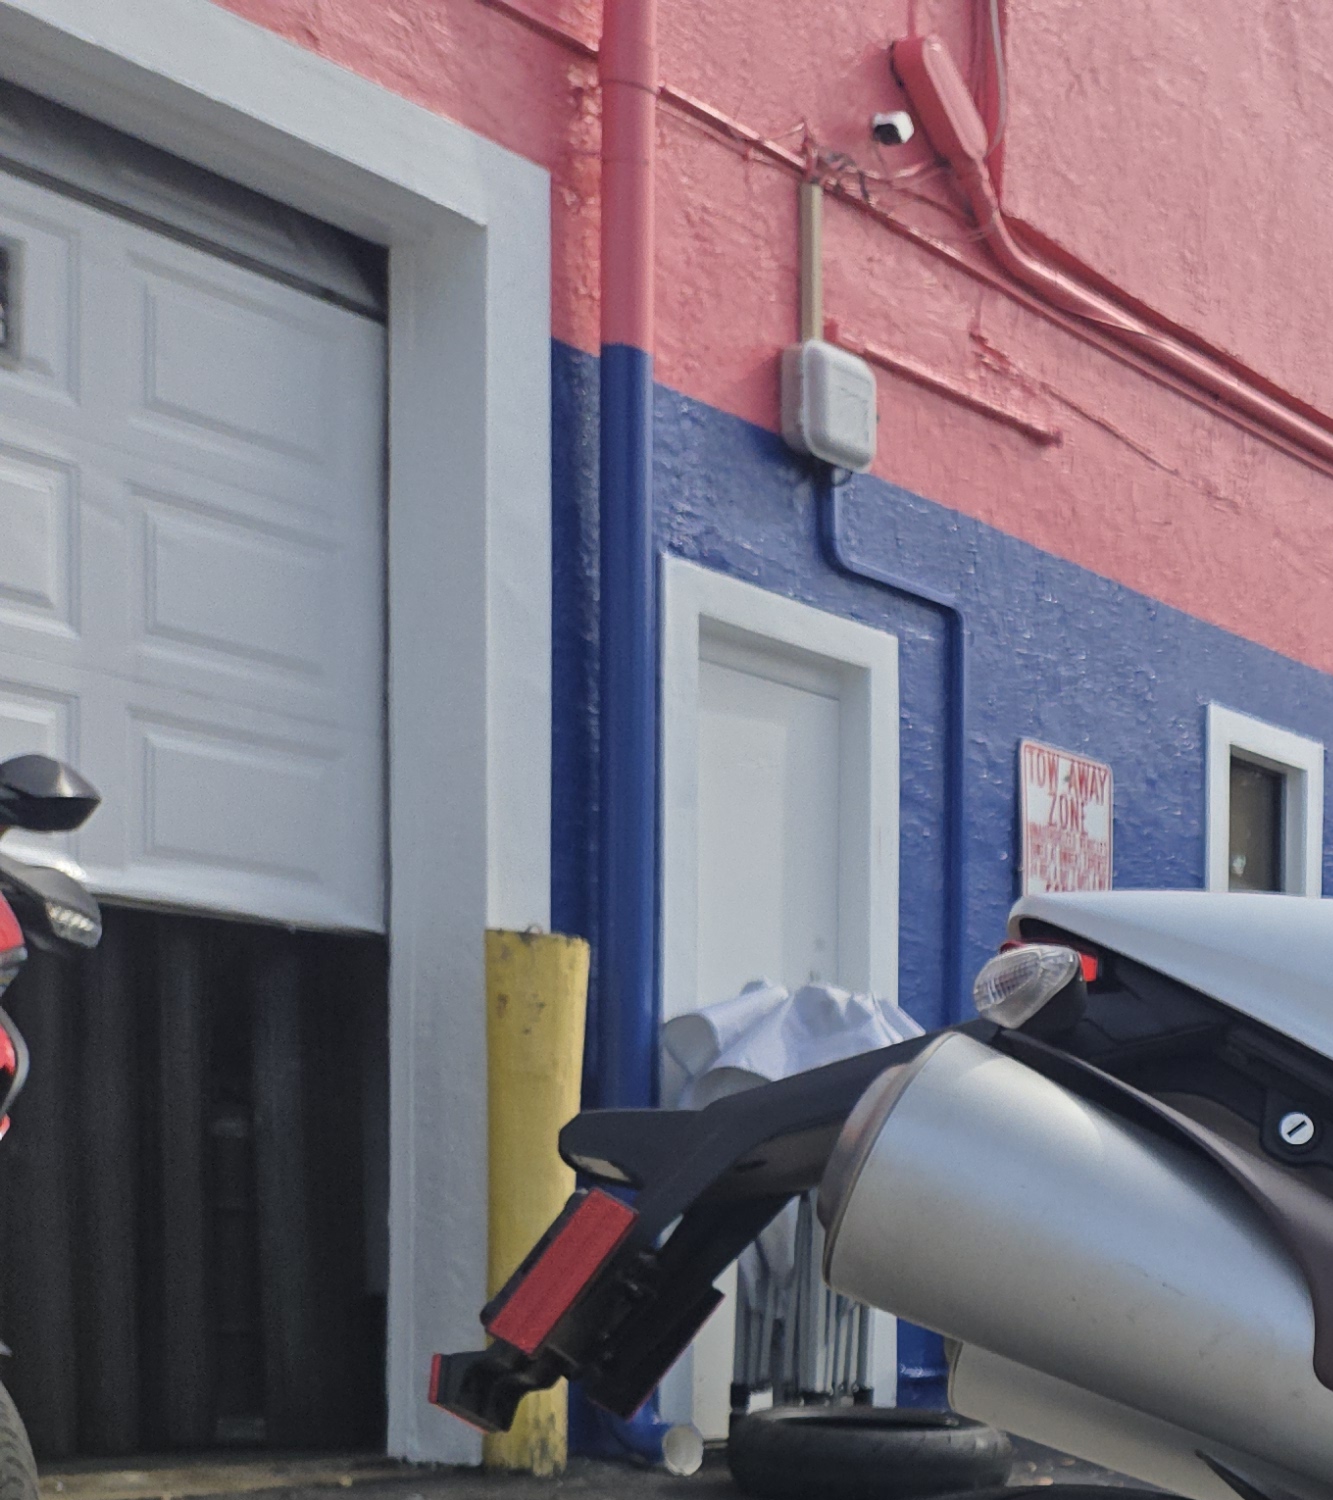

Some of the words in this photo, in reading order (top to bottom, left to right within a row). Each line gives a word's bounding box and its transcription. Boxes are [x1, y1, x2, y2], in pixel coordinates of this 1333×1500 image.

[1026, 748, 1060, 797] TOW
[1067, 759, 1109, 806] AWAY
[1048, 793, 1089, 836] ZONE
